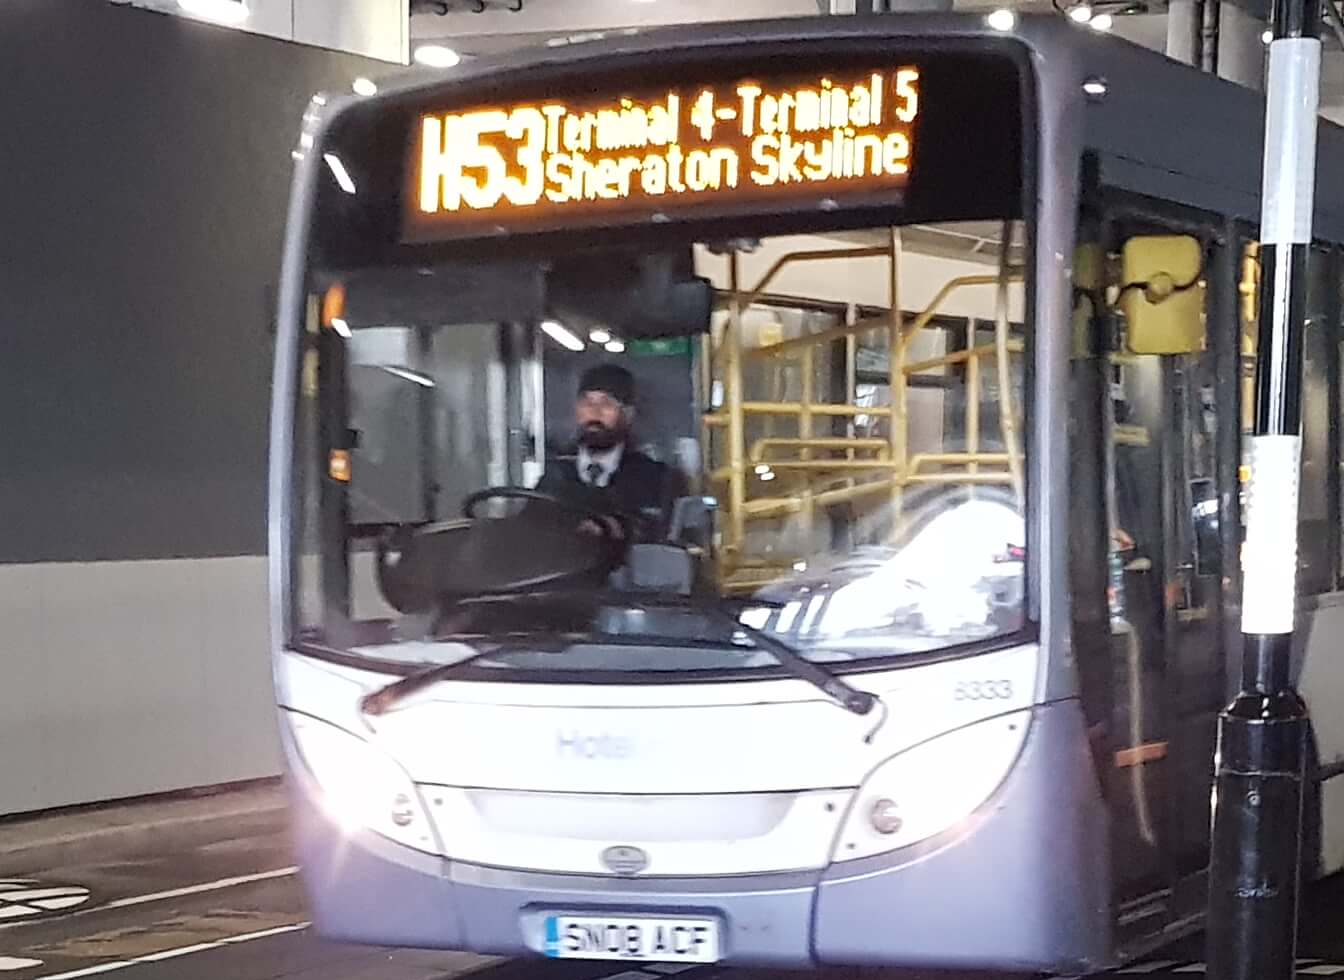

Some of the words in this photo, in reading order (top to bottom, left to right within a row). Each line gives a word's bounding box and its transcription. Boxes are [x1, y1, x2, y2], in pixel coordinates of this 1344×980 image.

[420, 107, 545, 213] H53
[542, 94, 679, 154] Terminal
[895, 69, 920, 122] 5
[545, 142, 739, 202] Sheraton
[751, 127, 910, 186] Skyline
[566, 922, 644, 953] SN08
[651, 925, 707, 956] ACF
